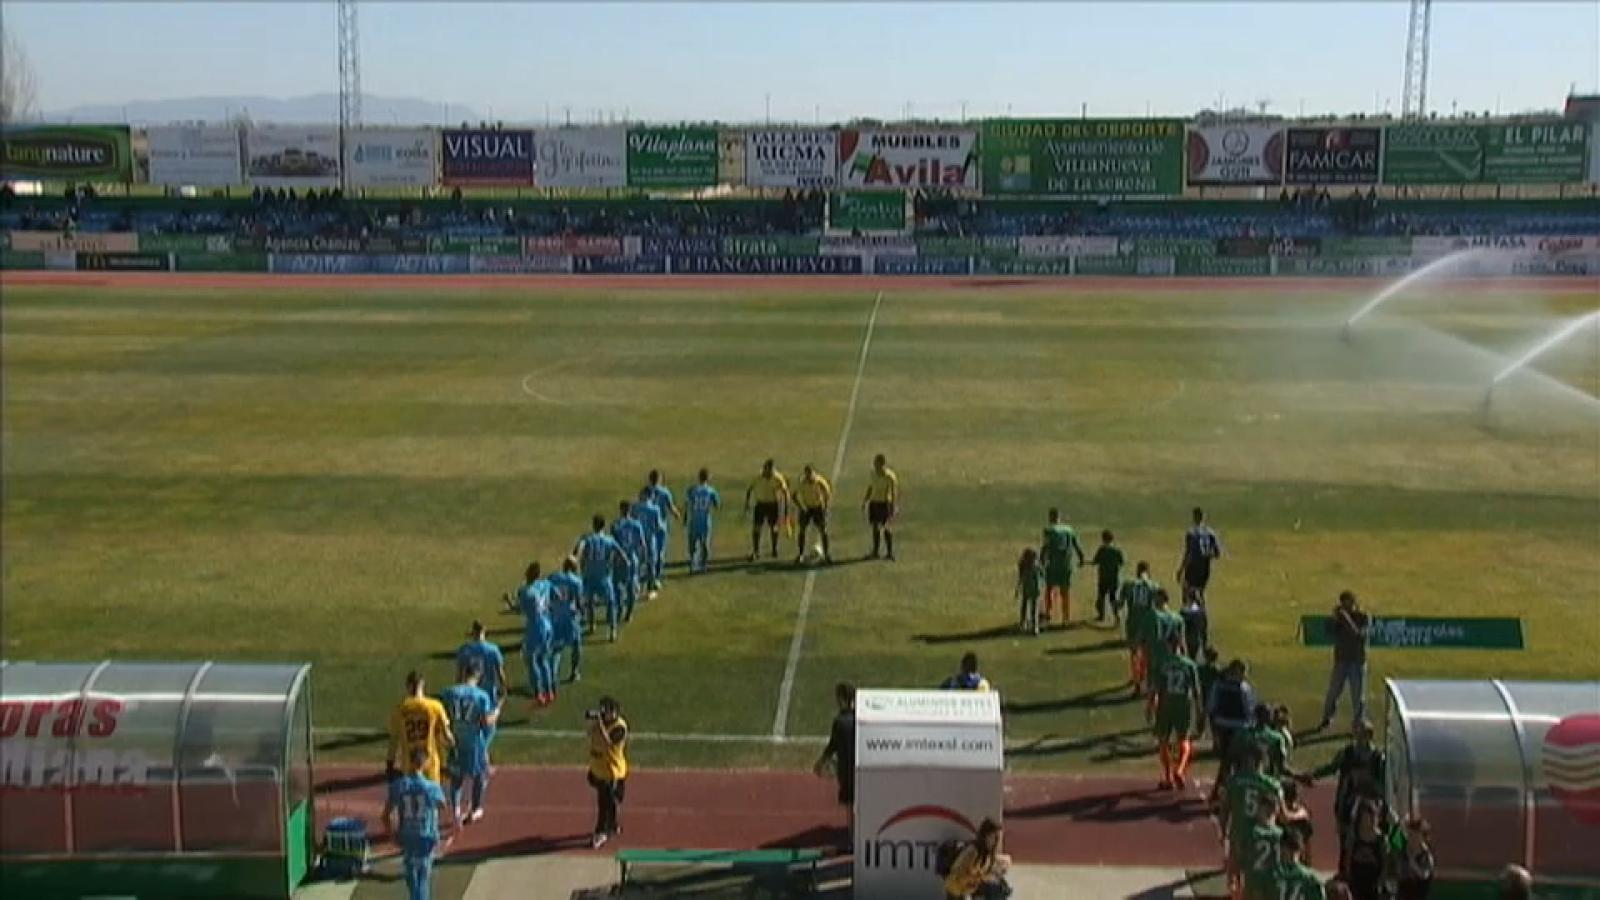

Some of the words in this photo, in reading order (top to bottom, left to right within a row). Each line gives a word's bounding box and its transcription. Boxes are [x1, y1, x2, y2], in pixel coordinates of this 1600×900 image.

[446, 134, 528, 158] VISUAL
[872, 133, 961, 149] MUEBLES
[1504, 126, 1525, 144] EL
[1531, 125, 1585, 145] PILAR
[402, 794, 426, 819] 11
[863, 839, 948, 869] IMT
